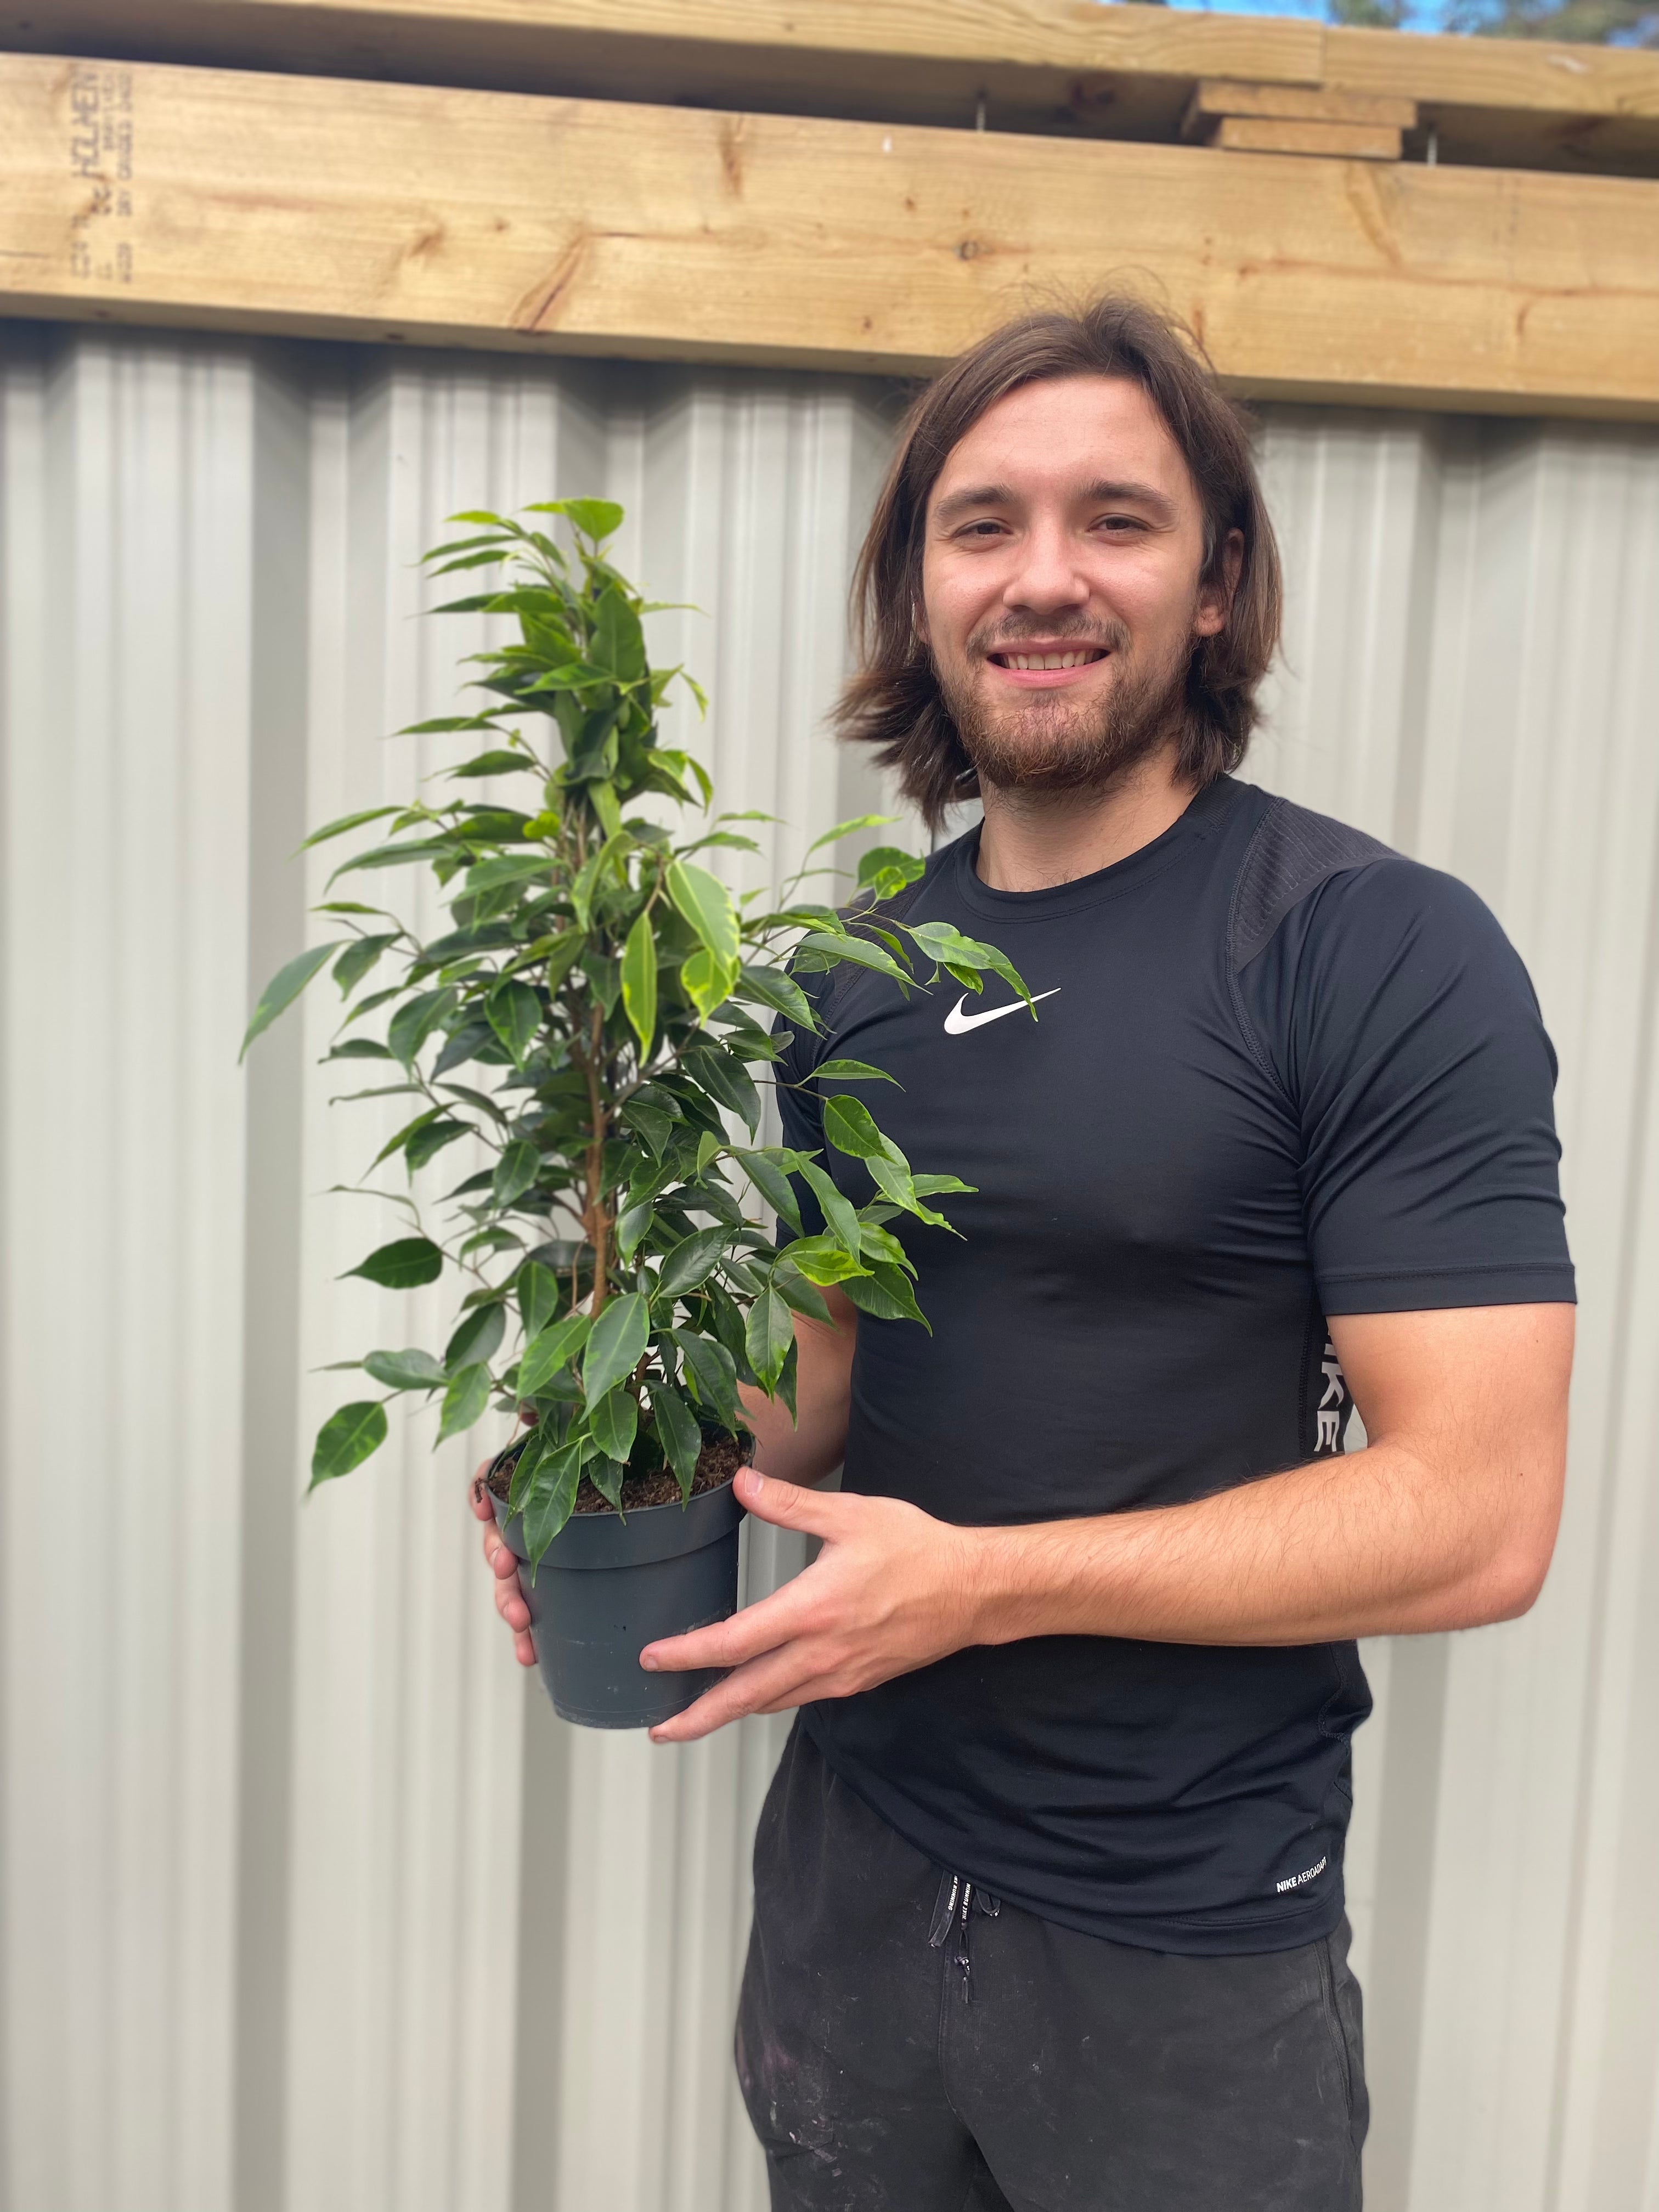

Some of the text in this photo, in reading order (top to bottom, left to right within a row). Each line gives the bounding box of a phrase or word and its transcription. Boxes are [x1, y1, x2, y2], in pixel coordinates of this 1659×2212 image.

[1314, 1328, 1344, 1452] KE
[948, 1884, 957, 1911] RUNNING
[1276, 1876, 1297, 1893] NIKE
